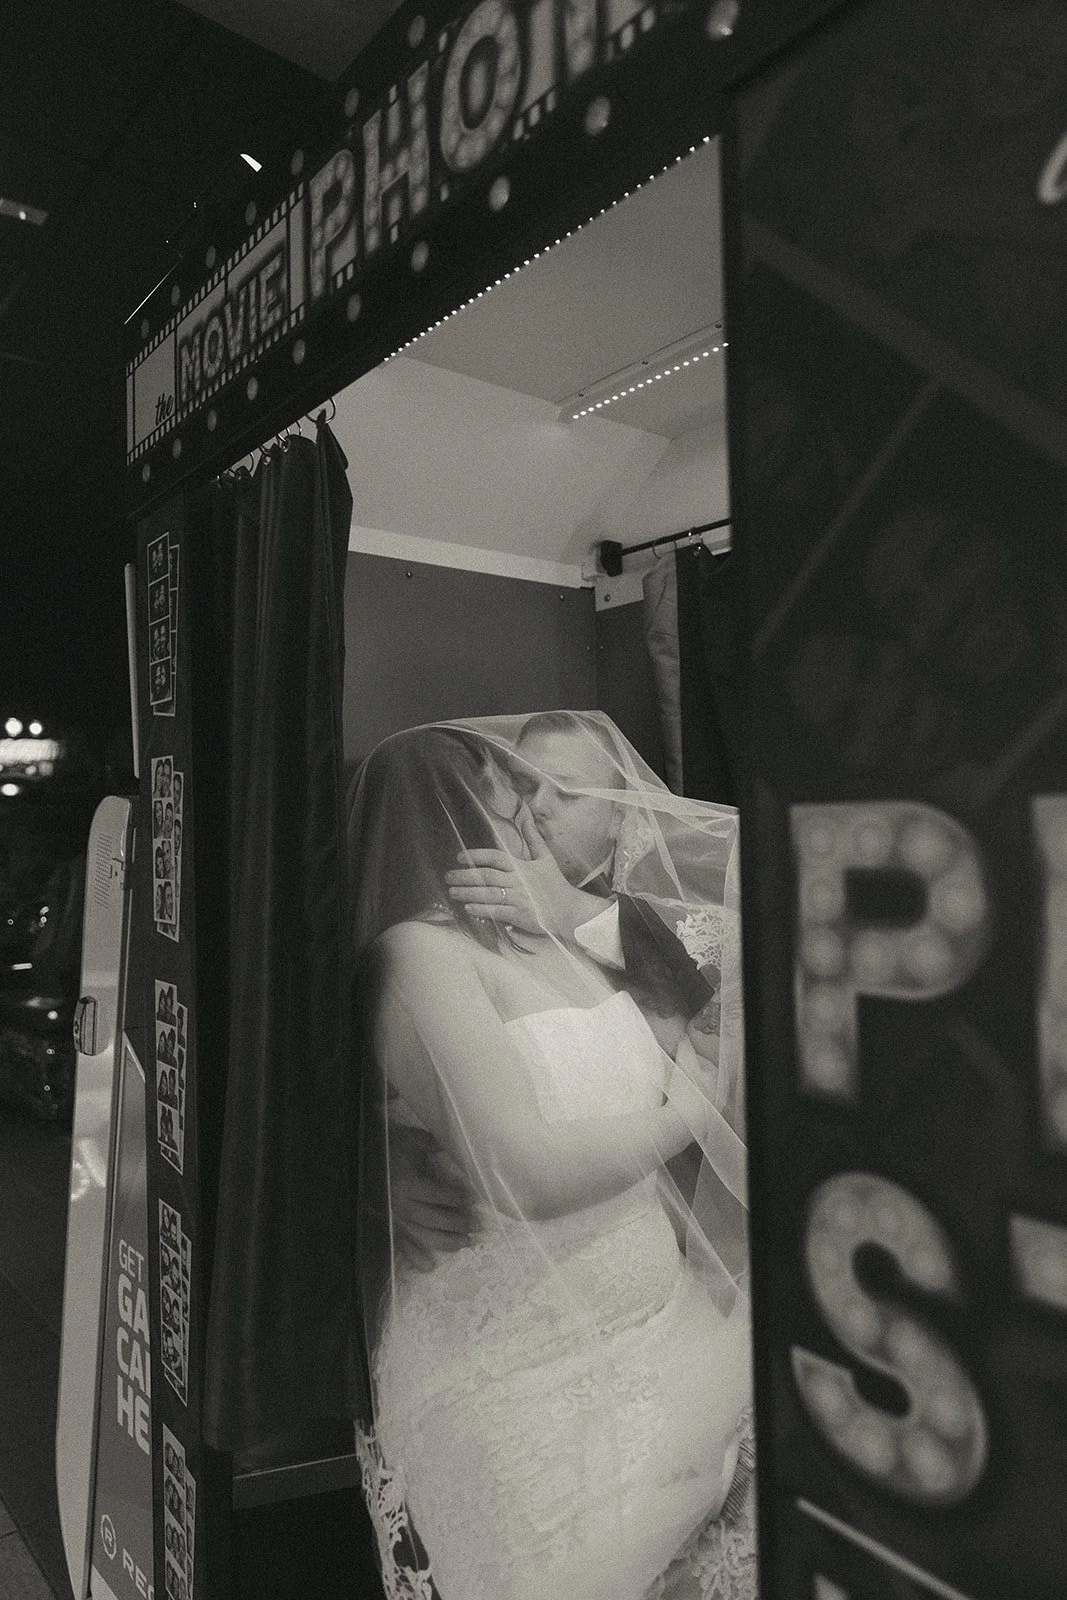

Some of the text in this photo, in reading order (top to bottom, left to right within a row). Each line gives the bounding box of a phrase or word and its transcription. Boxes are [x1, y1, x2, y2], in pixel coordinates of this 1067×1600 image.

[155, 393, 174, 425] the
[180, 254, 282, 402] MOVIE
[119, 1239, 144, 1282] GET
